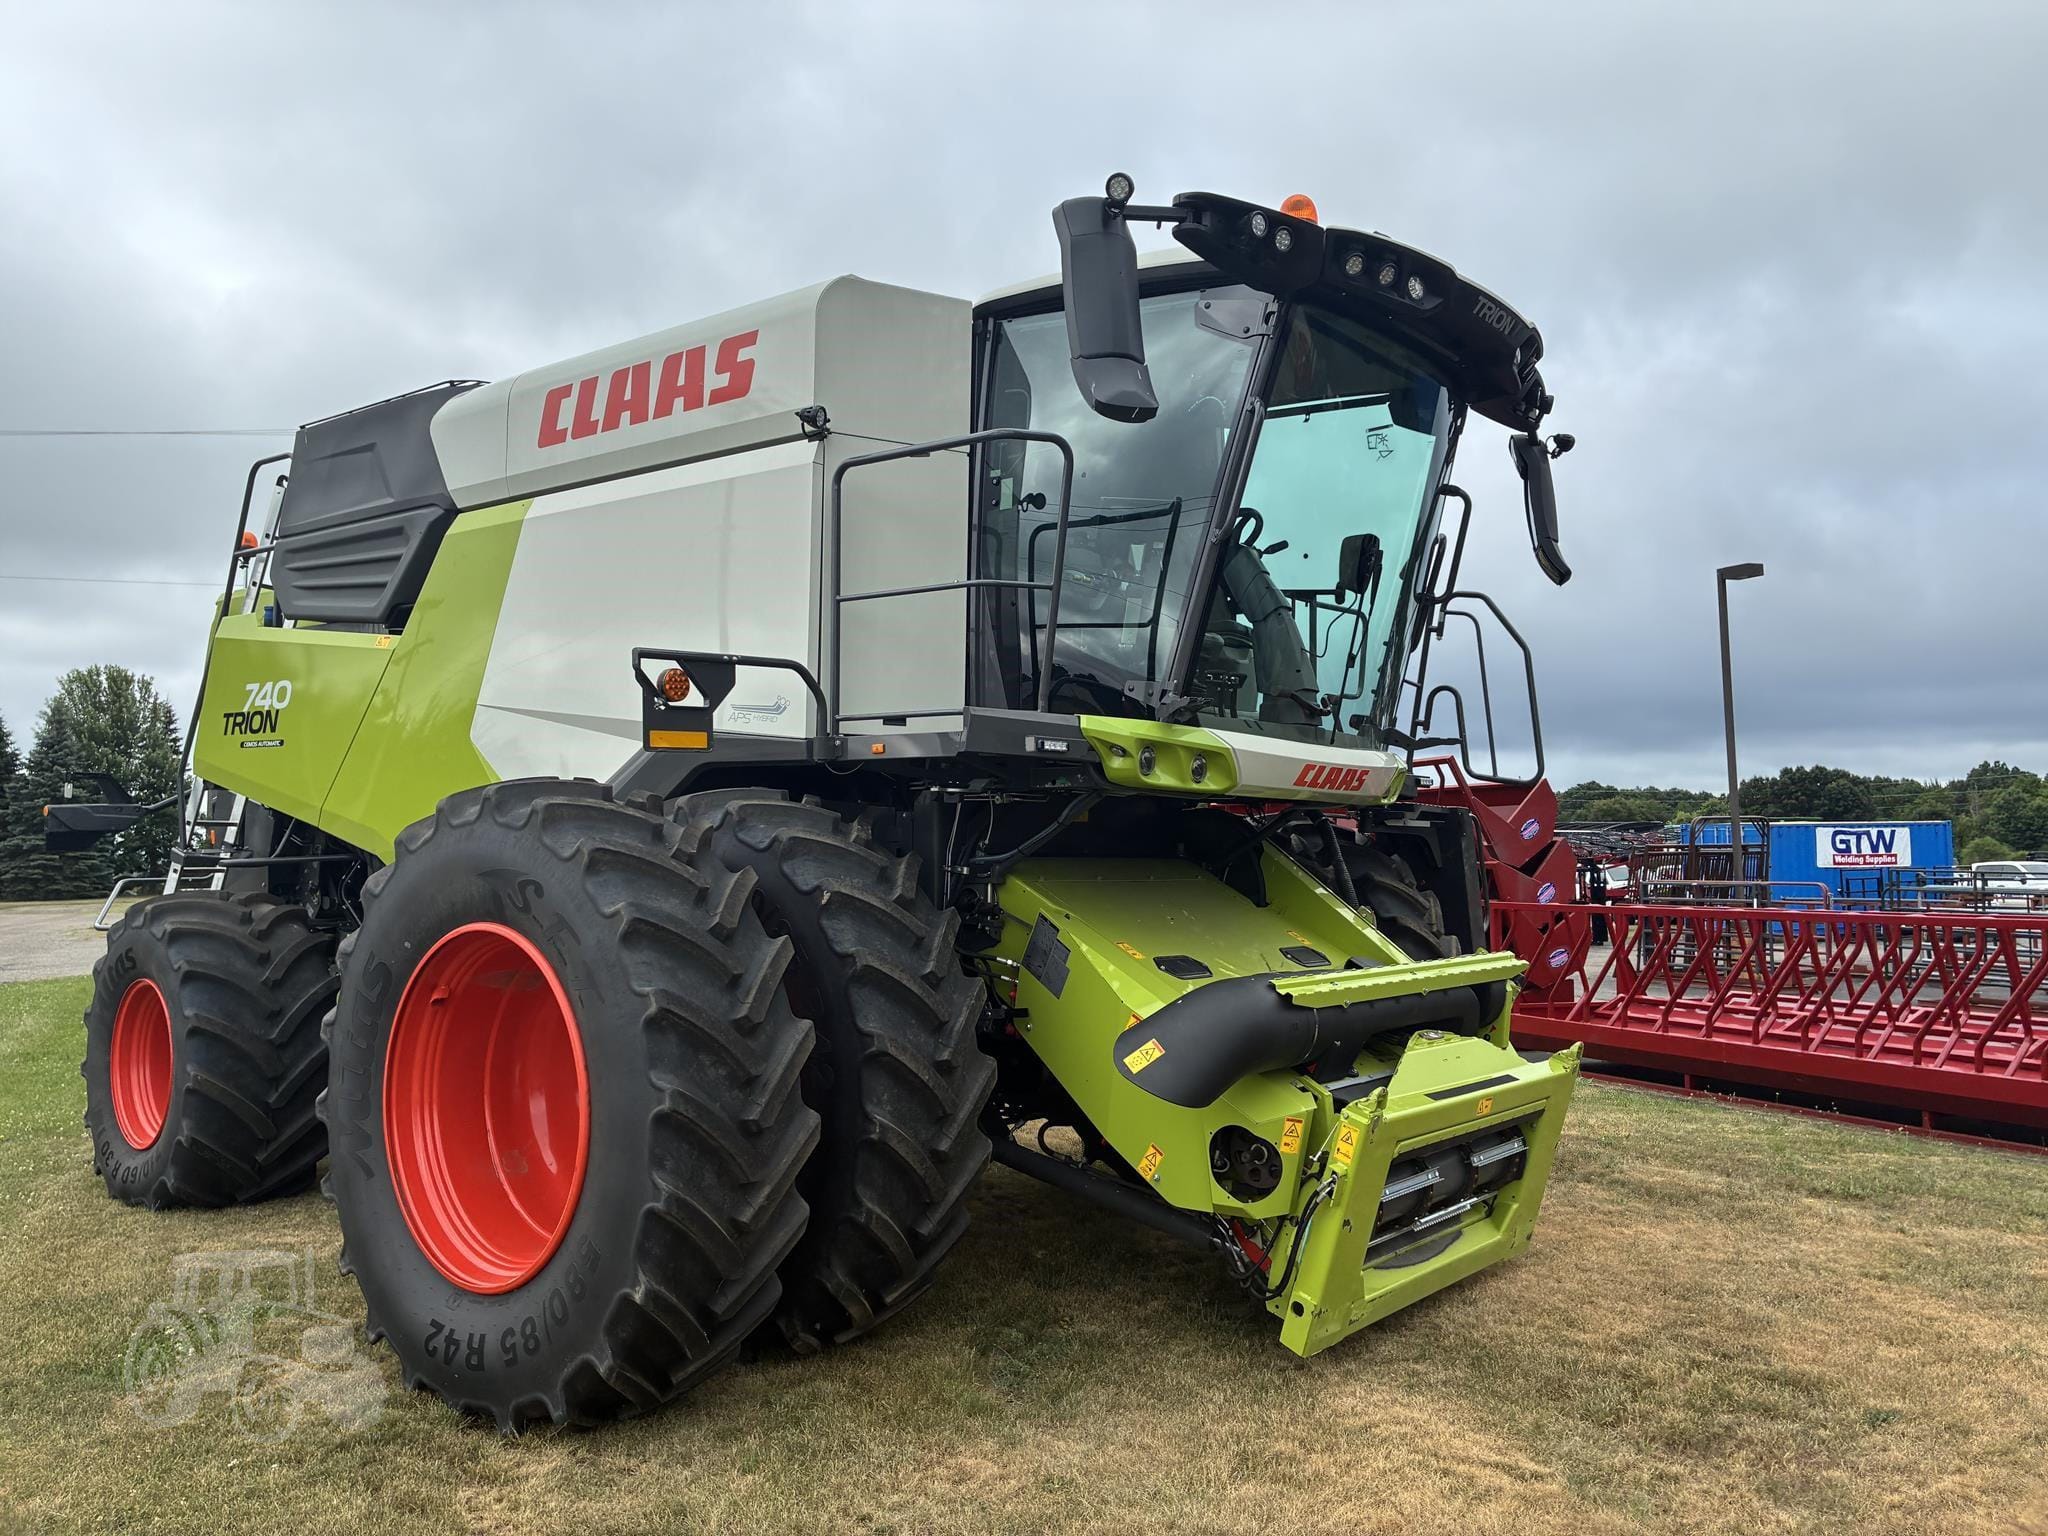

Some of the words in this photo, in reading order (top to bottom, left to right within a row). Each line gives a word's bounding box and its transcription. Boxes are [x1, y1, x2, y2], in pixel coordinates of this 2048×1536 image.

[1472, 295, 1516, 336] TRION
[537, 329, 760, 449] CLAAS
[243, 680, 292, 712] 740
[223, 710, 280, 735] TRION
[728, 712, 753, 724] APS
[1292, 763, 1371, 792] CLAAS
[1831, 829, 1897, 854] GTW
[1834, 855, 1864, 864] Welding
[1865, 854, 1896, 865] Supplies
